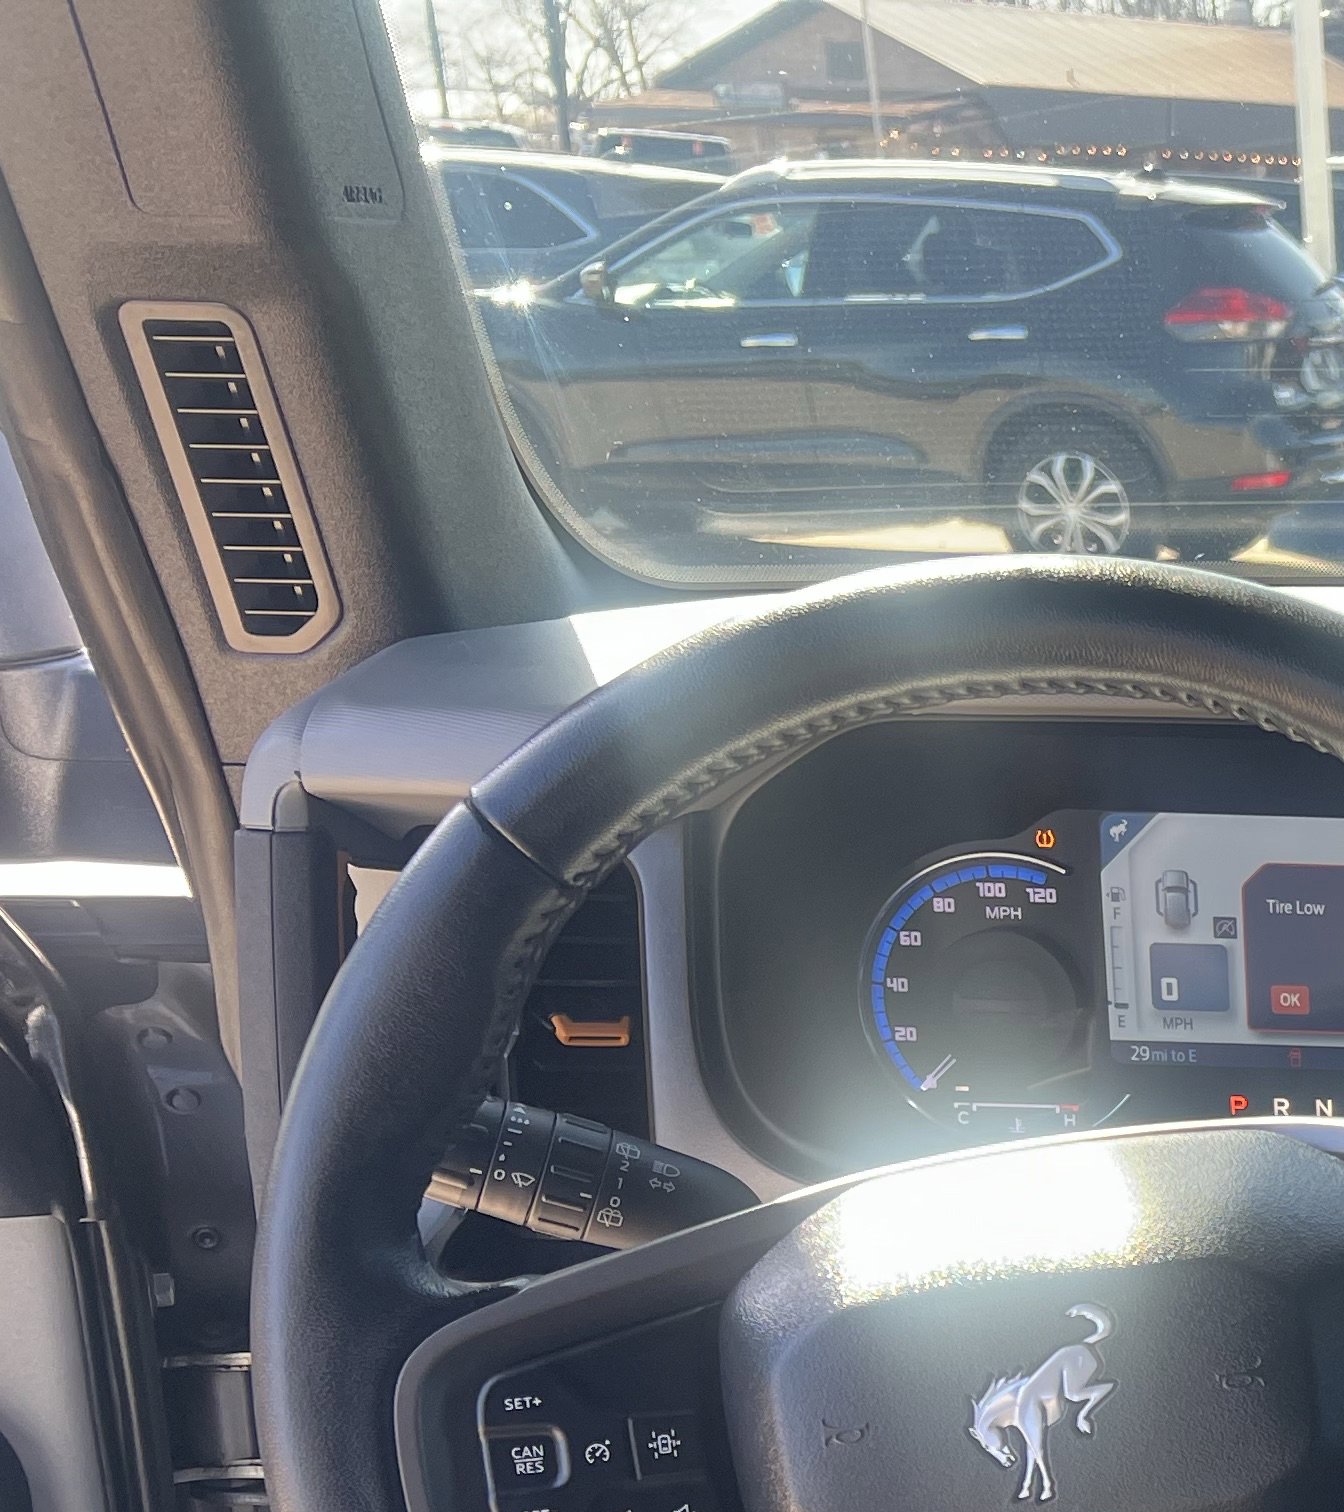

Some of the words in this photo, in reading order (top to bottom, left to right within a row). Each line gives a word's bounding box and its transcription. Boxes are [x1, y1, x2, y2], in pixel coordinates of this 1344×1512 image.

[976, 882, 1006, 898] 100
[1026, 887, 1057, 904] 120
[933, 897, 956, 913] 80
[1266, 899, 1292, 914] Tire
[1296, 900, 1326, 915] Low
[985, 906, 1022, 920] MPH
[1112, 907, 1121, 920] F
[899, 931, 922, 946] 60
[886, 978, 909, 993] 40
[1160, 977, 1179, 1001] 0
[1279, 992, 1302, 1008] OK
[1117, 1015, 1126, 1028] E
[1162, 1017, 1194, 1031] MPH
[894, 1026, 917, 1042] 20
[1172, 1050, 1186, 1063] to
[1188, 1050, 1197, 1063] E
[1229, 1094, 1248, 1115] P
[1273, 1098, 1290, 1116] R
[1315, 1099, 1333, 1117] N
[957, 1111, 970, 1125] C
[1063, 1114, 1076, 1128] H
[504, 1396, 542, 1411] SET+
[511, 1445, 544, 1460] CAN
[515, 1460, 545, 1475] RES
